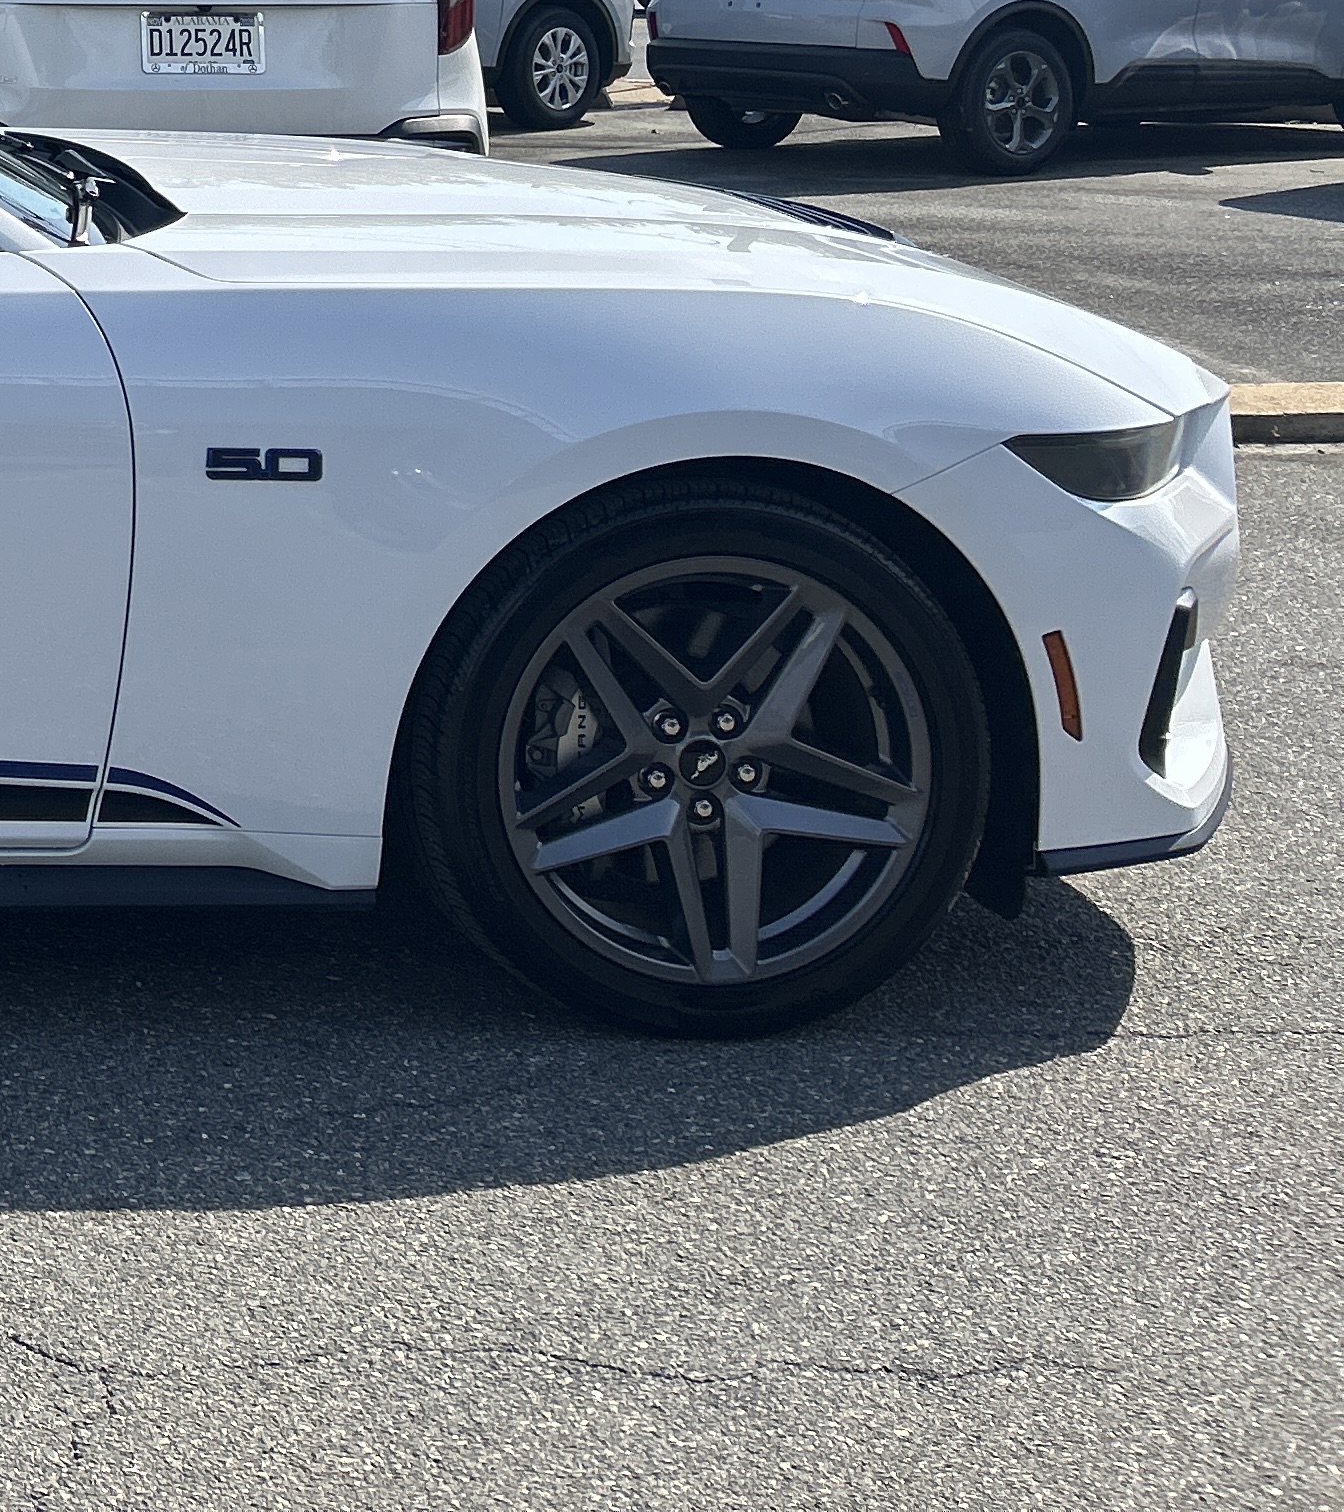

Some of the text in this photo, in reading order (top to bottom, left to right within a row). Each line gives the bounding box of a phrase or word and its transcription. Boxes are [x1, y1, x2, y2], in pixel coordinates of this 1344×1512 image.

[173, 16, 231, 26] ALABAMA
[149, 28, 253, 58] D12524R
[192, 62, 229, 74] Dothan
